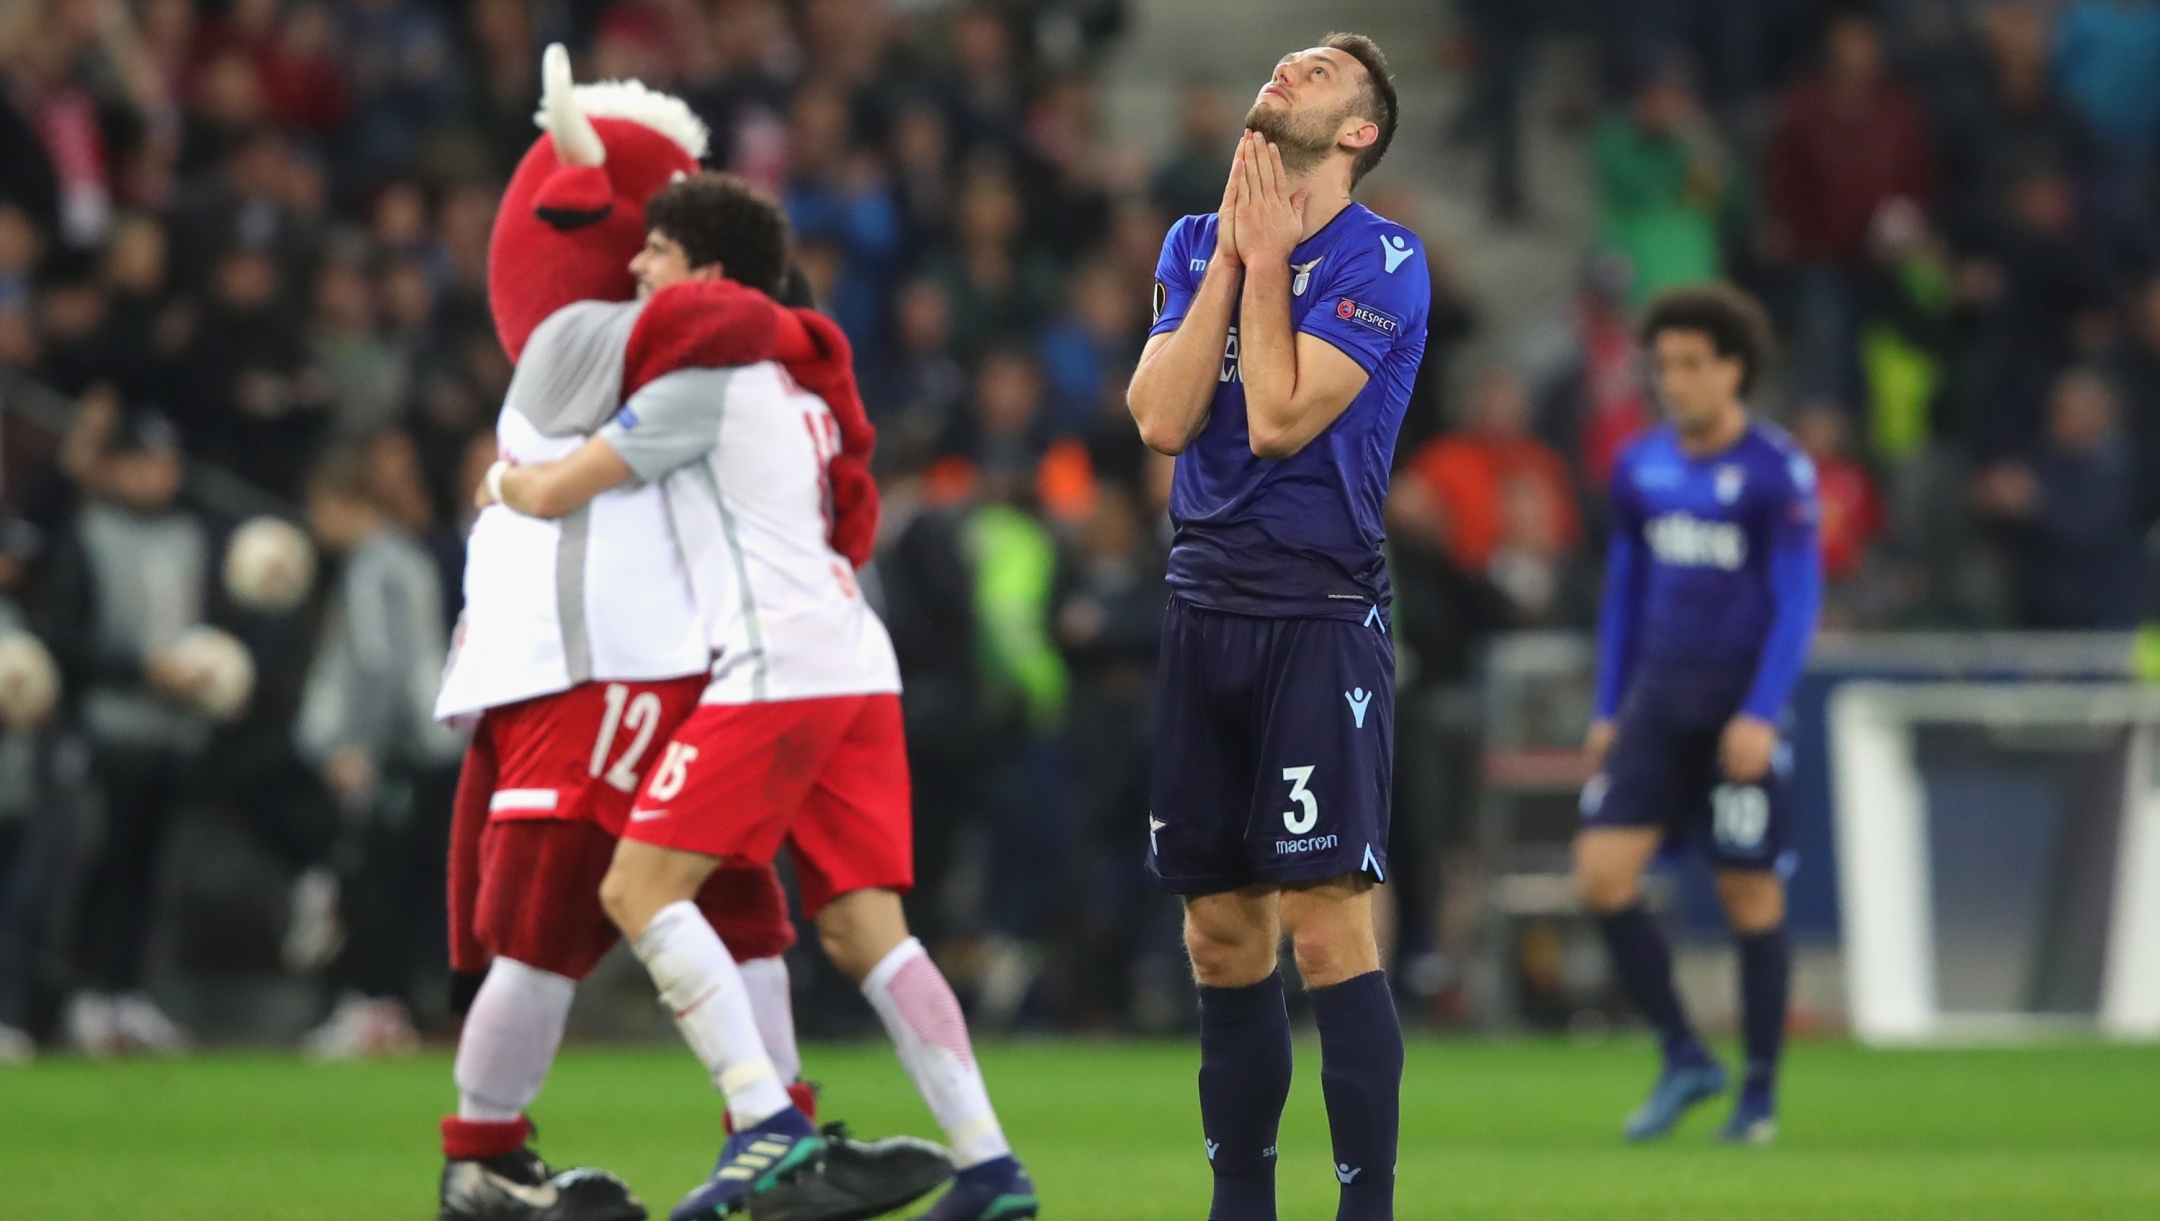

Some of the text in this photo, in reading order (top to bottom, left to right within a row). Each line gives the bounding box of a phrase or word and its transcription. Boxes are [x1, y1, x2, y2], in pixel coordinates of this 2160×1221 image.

[1354, 308, 1397, 332] RESPECT
[588, 682, 662, 794] 12
[647, 740, 699, 802] 15
[1282, 764, 1318, 835] 3
[1275, 834, 1338, 855] macron
